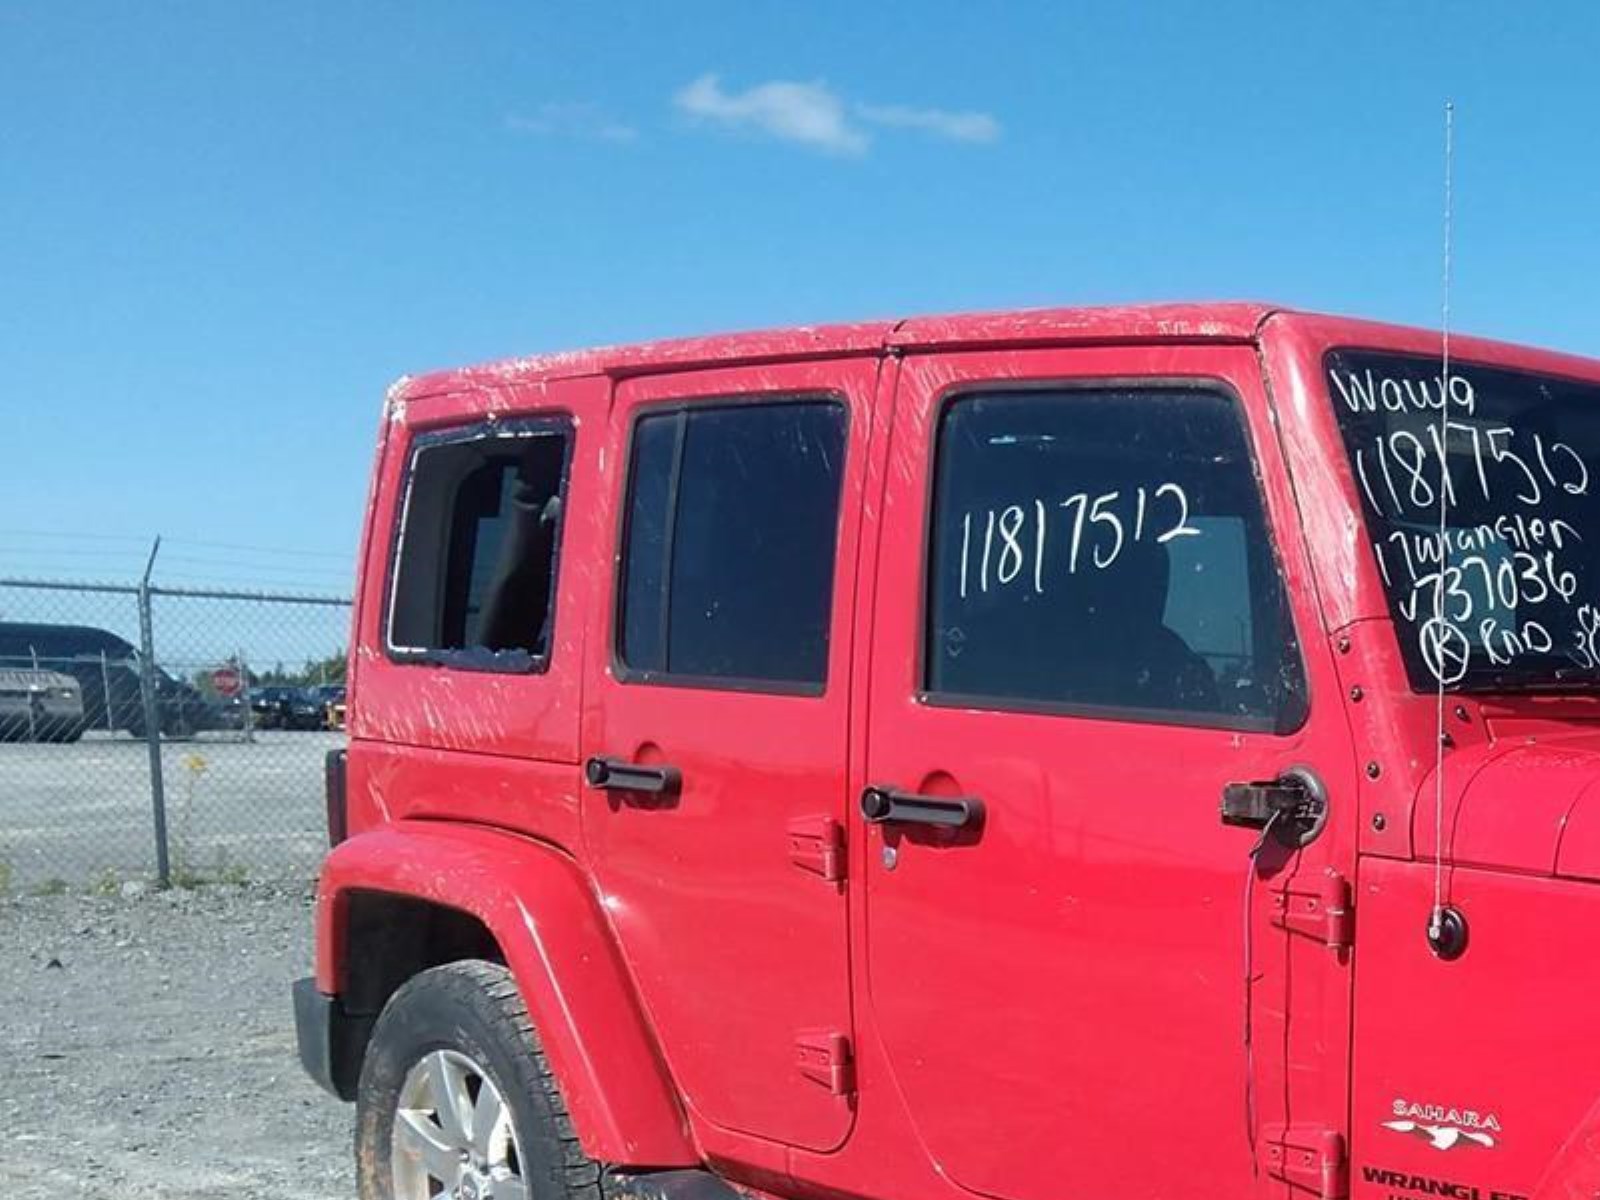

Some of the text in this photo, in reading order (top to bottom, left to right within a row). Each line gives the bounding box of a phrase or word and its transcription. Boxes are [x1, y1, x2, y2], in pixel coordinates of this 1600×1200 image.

[1330, 369, 1474, 415] Wawa
[1357, 423, 1588, 516] 11817512
[962, 483, 1200, 598] 11817512
[1393, 1099, 1500, 1131] SAHARA
